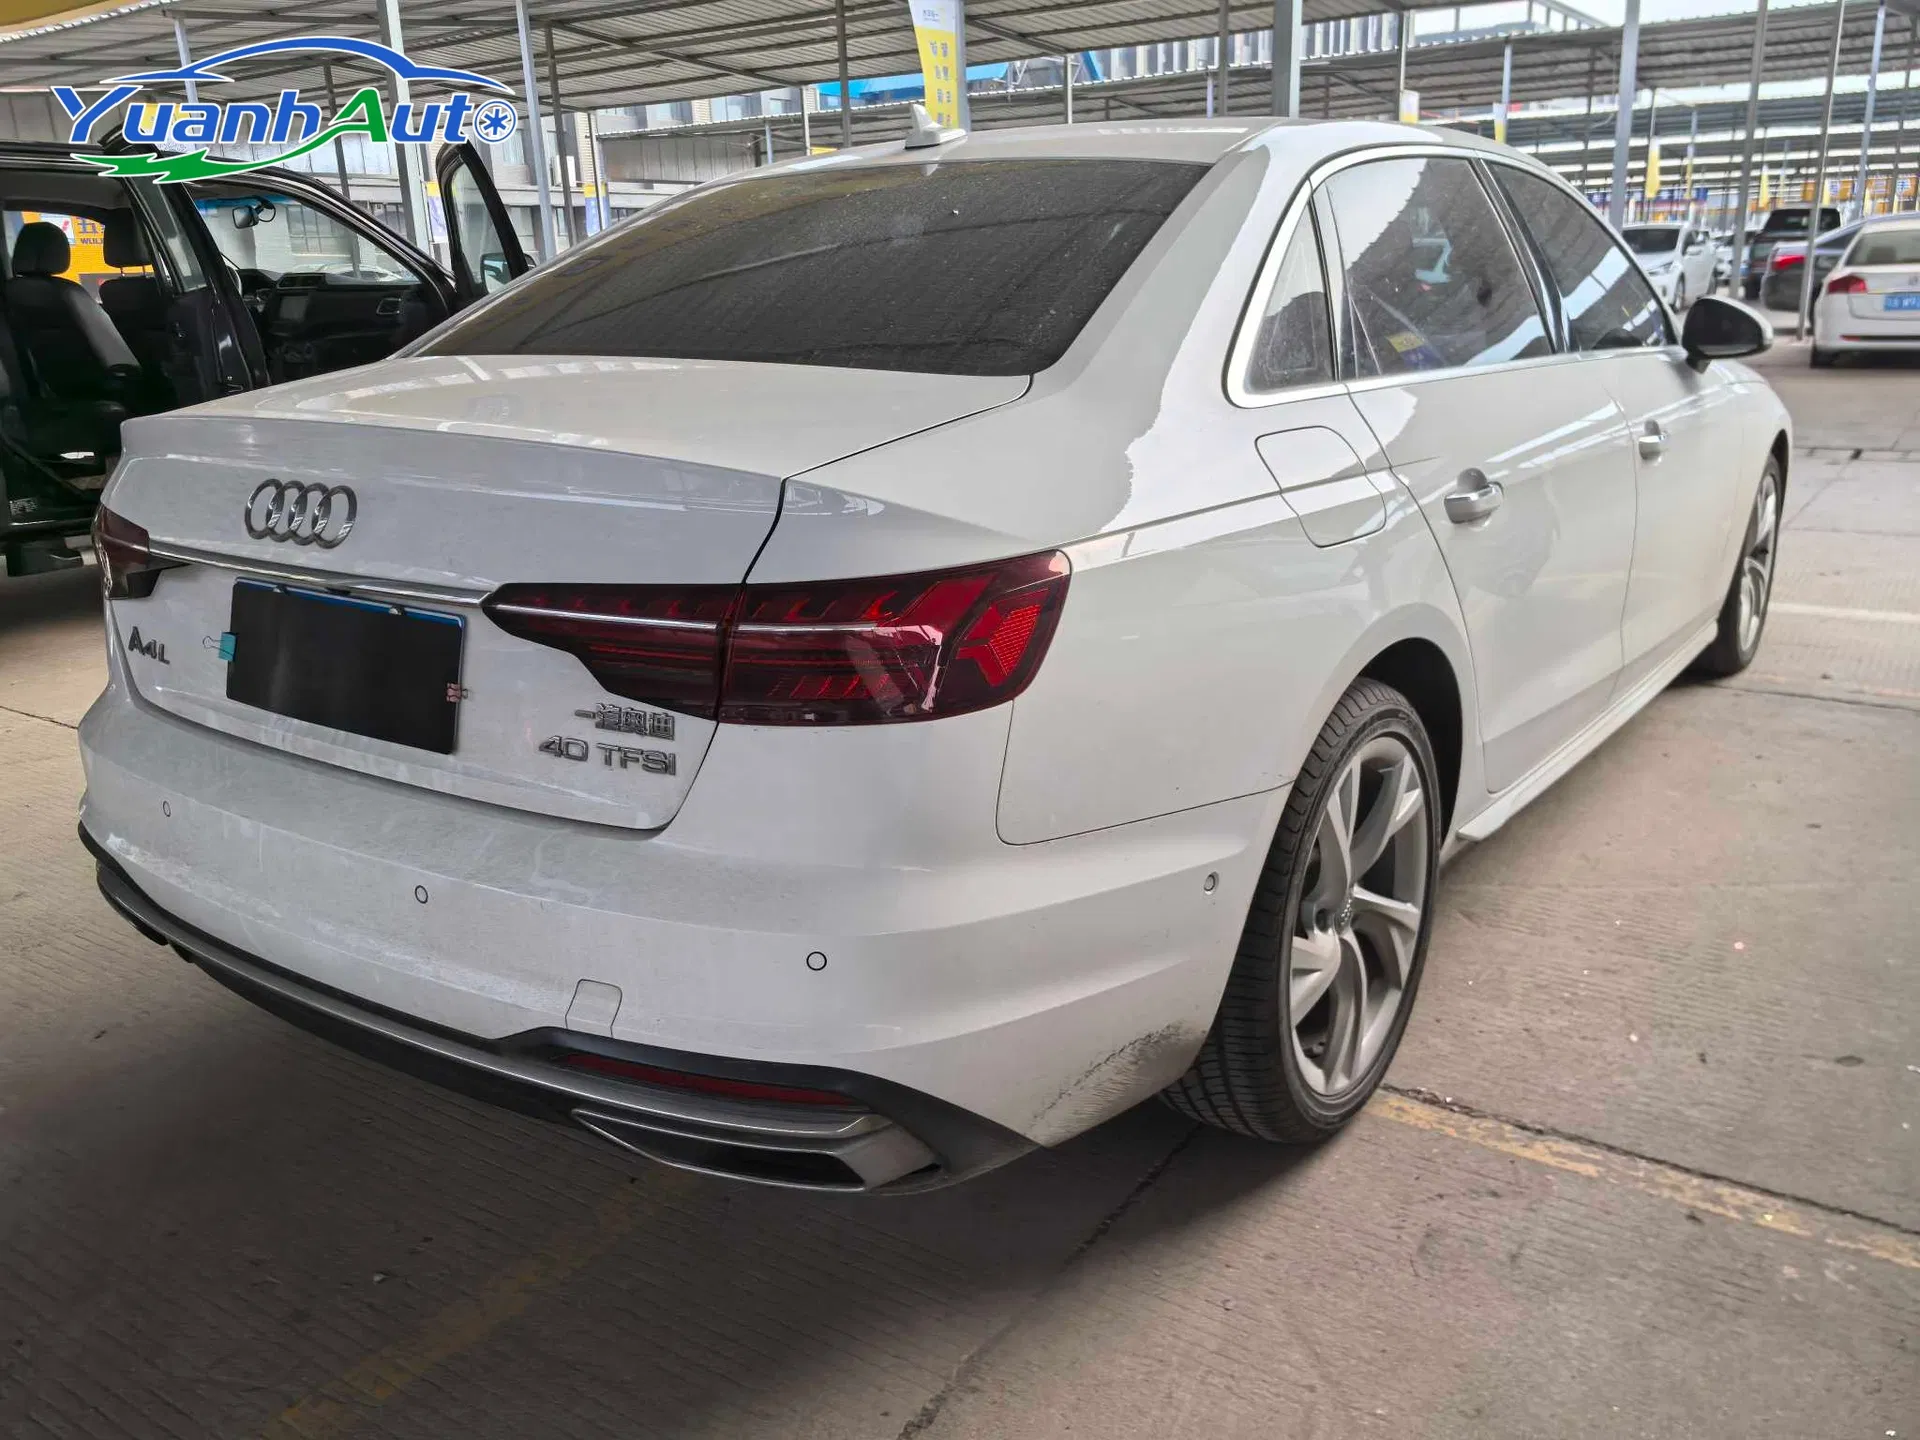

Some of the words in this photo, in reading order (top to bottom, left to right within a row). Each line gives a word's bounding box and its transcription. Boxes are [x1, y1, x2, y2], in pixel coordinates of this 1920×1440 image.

[128, 626, 170, 665] A4L
[539, 735, 589, 762] 40
[596, 742, 676, 776] TFSI
